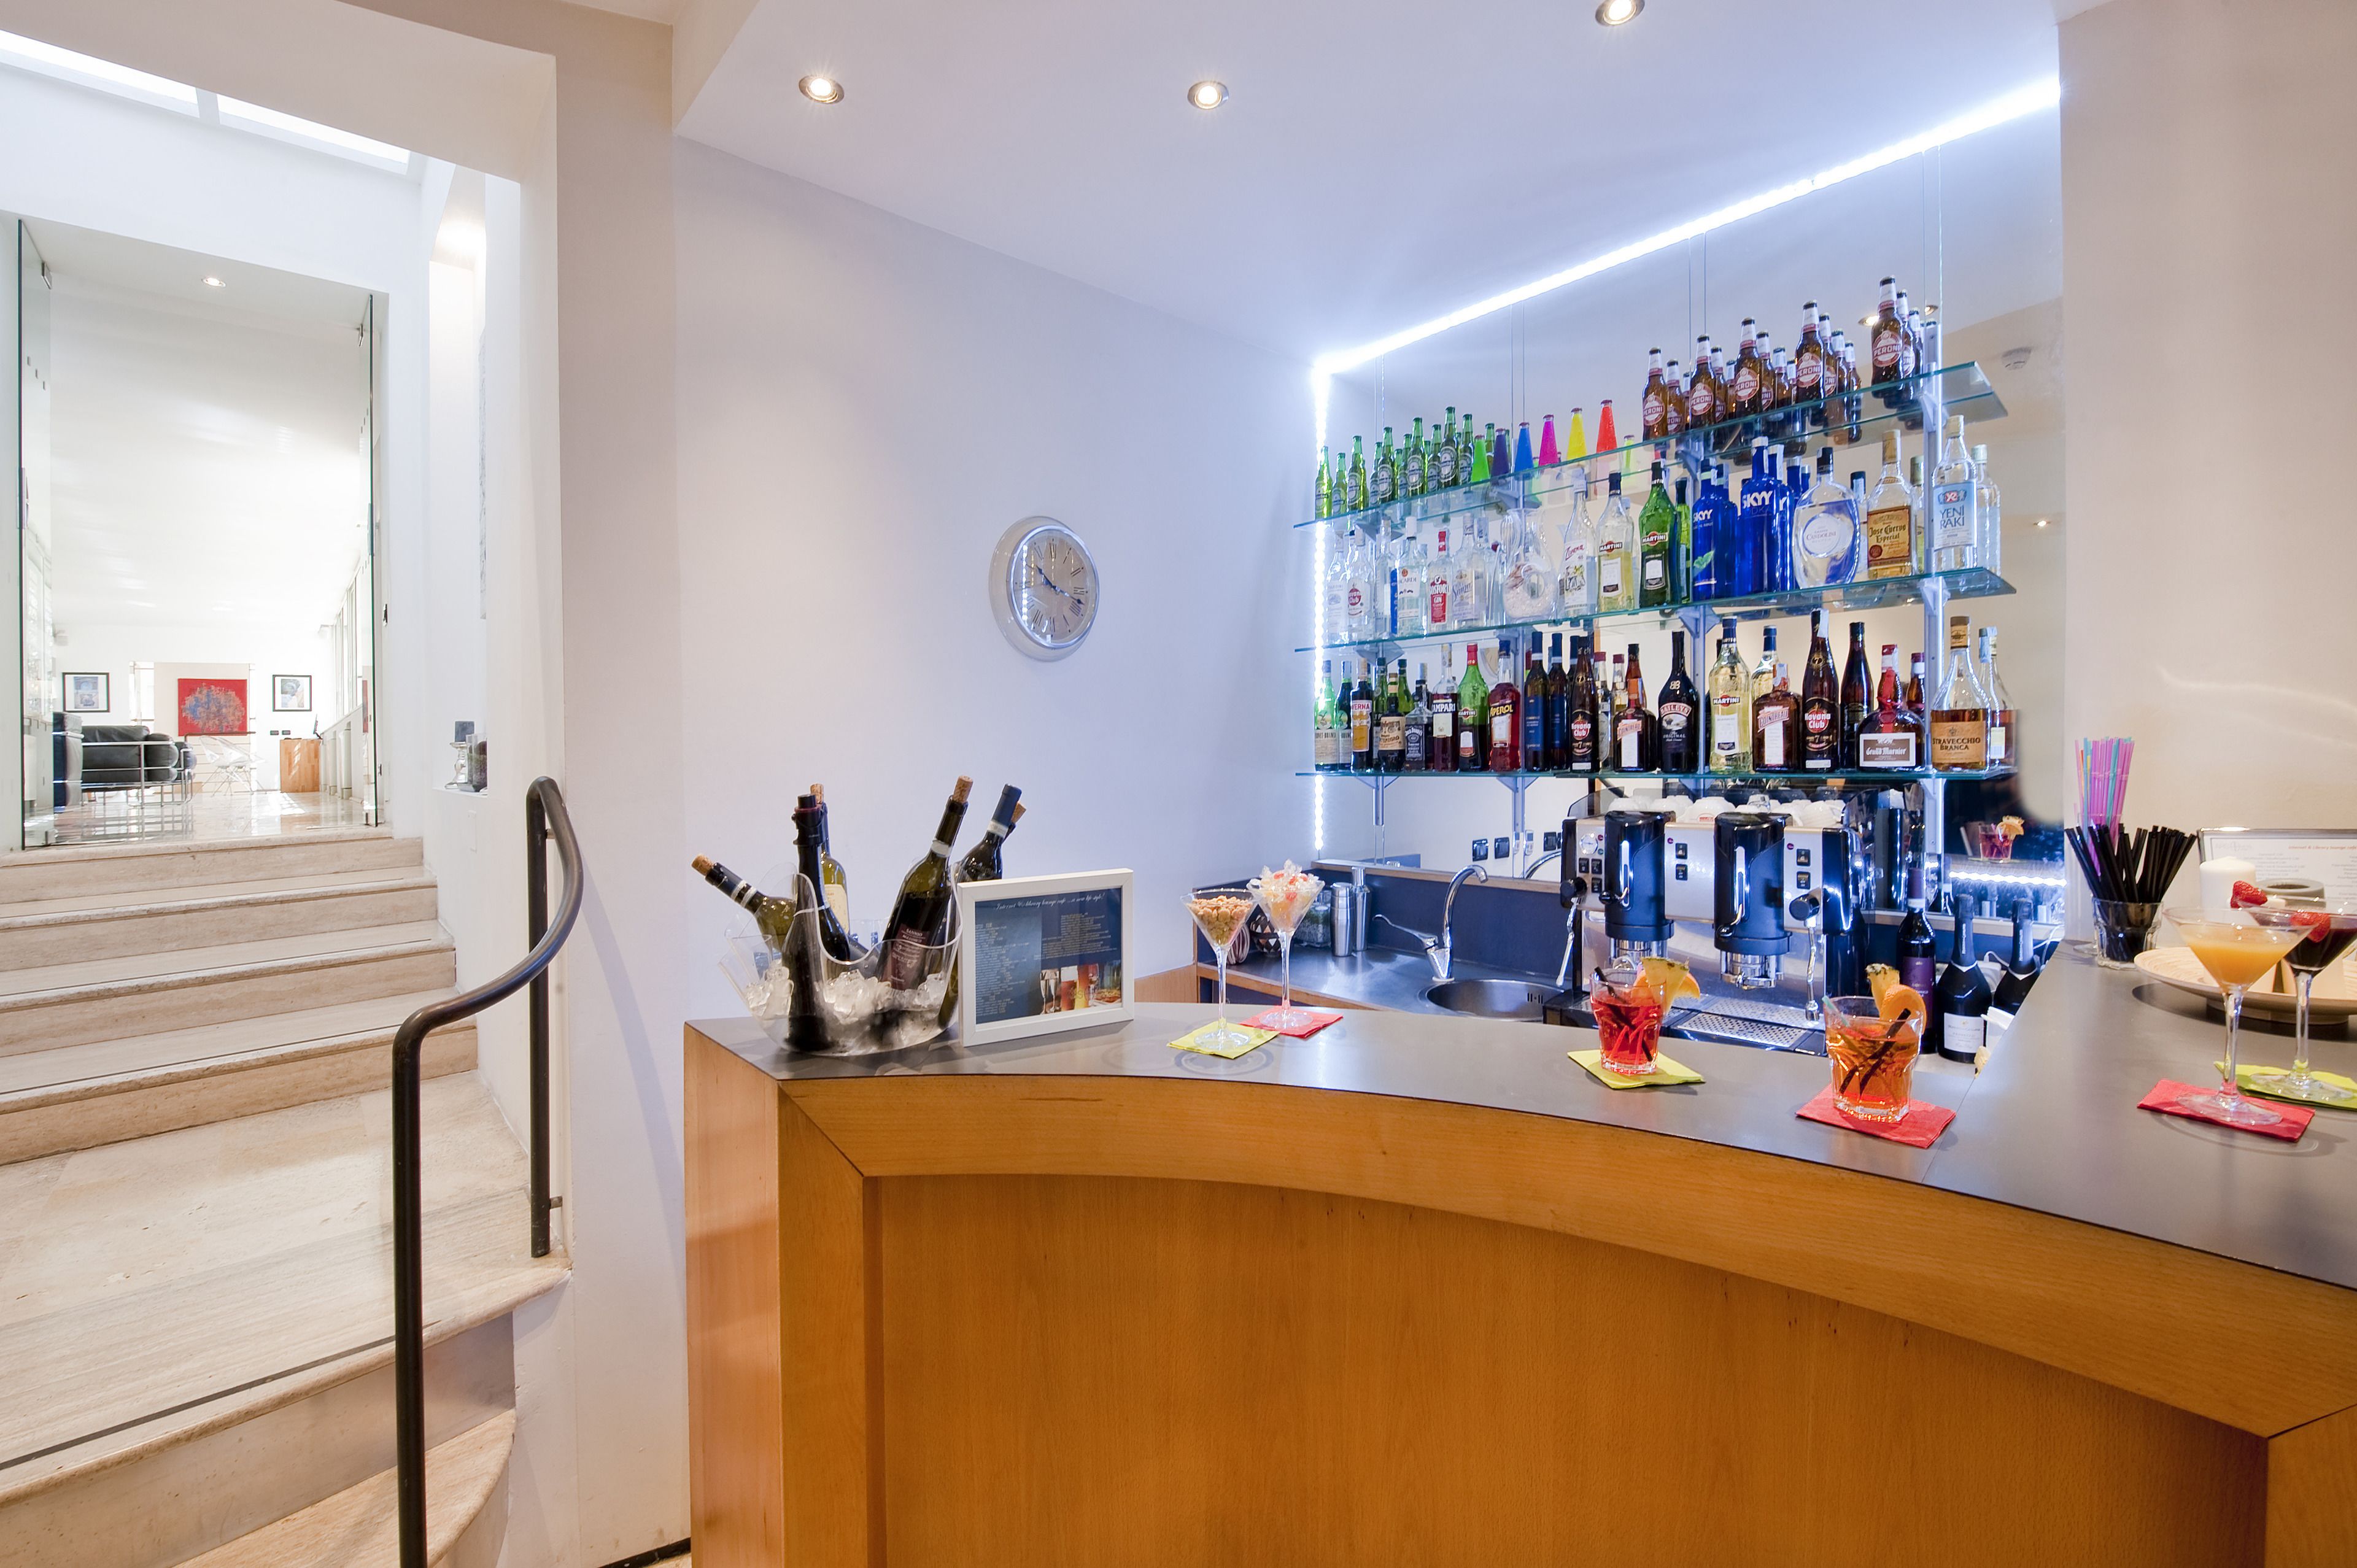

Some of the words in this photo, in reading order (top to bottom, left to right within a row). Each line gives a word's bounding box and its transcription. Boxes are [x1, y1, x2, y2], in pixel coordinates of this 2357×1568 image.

[1874, 346, 1901, 356] PERONI
[1797, 365, 1821, 376] PERONI
[1735, 380, 1757, 391] PERONI
[1690, 396, 1711, 405] PERONI
[1643, 406, 1663, 415] PERONI
[1742, 491, 1773, 509] SKYY
[1693, 509, 1713, 523] SKYY
[1940, 504, 1964, 519] YENI
[1940, 516, 1964, 530] RAKI
[1870, 527, 1883, 538] Jose
[1884, 524, 1906, 535] Cuervo
[1876, 532, 1901, 543] Especial
[1600, 543, 1622, 552] MARTINI
[1490, 705, 1514, 717] APEROL
[1660, 703, 1690, 716] BAILEYS
[1759, 710, 1789, 728] COINTREAU
[1804, 713, 1831, 721] Havana
[1808, 720, 1825, 729] Club
